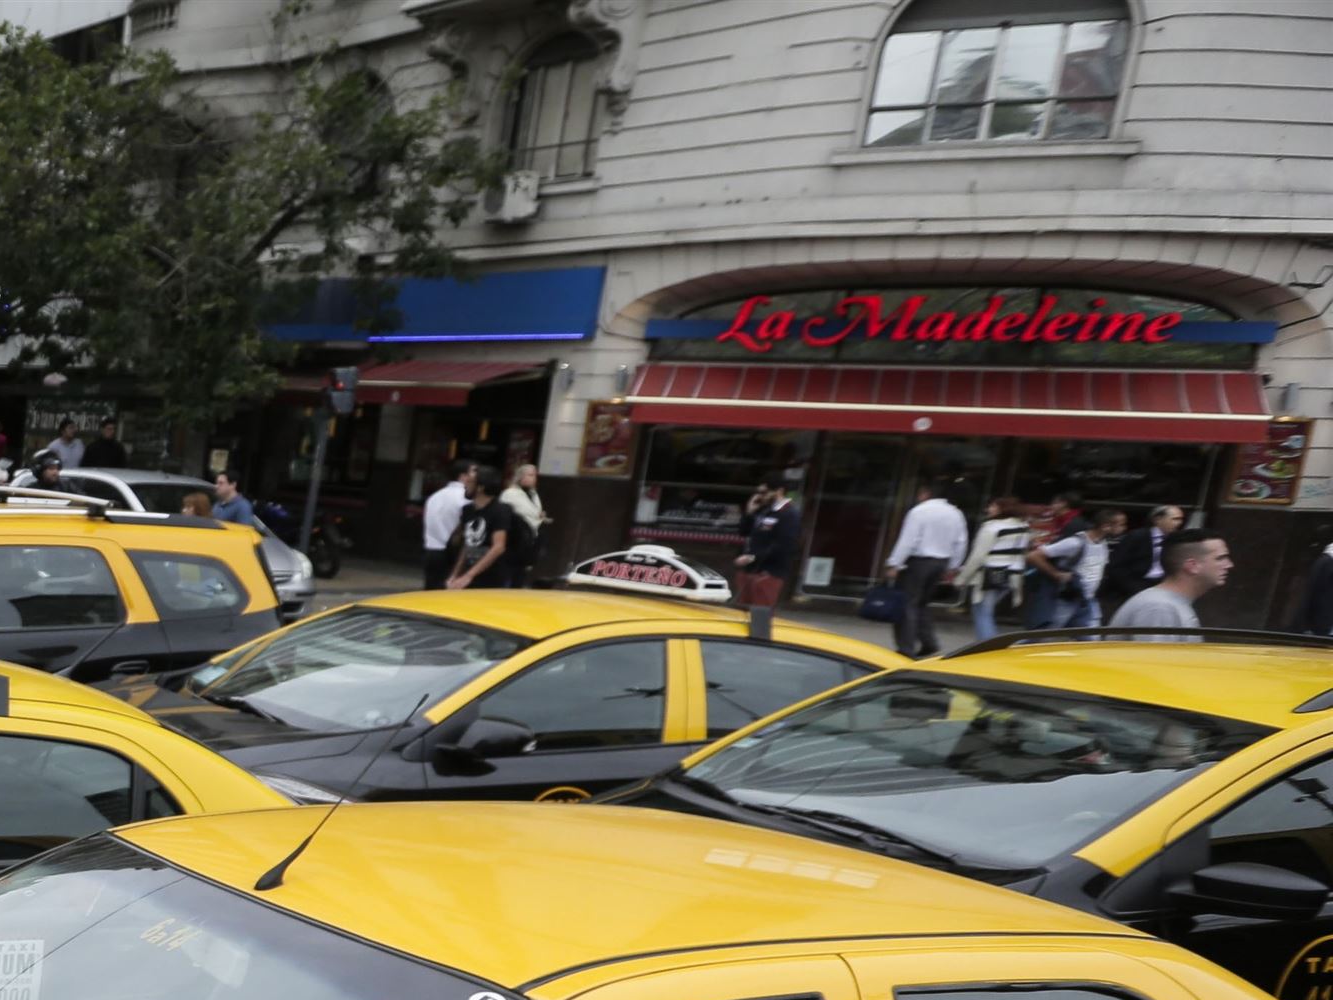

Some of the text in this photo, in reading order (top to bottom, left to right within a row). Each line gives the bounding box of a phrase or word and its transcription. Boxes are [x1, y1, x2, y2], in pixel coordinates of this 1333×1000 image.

[716, 295, 1182, 352] La Madeleine
[590, 560, 688, 588] PORTEÑO
